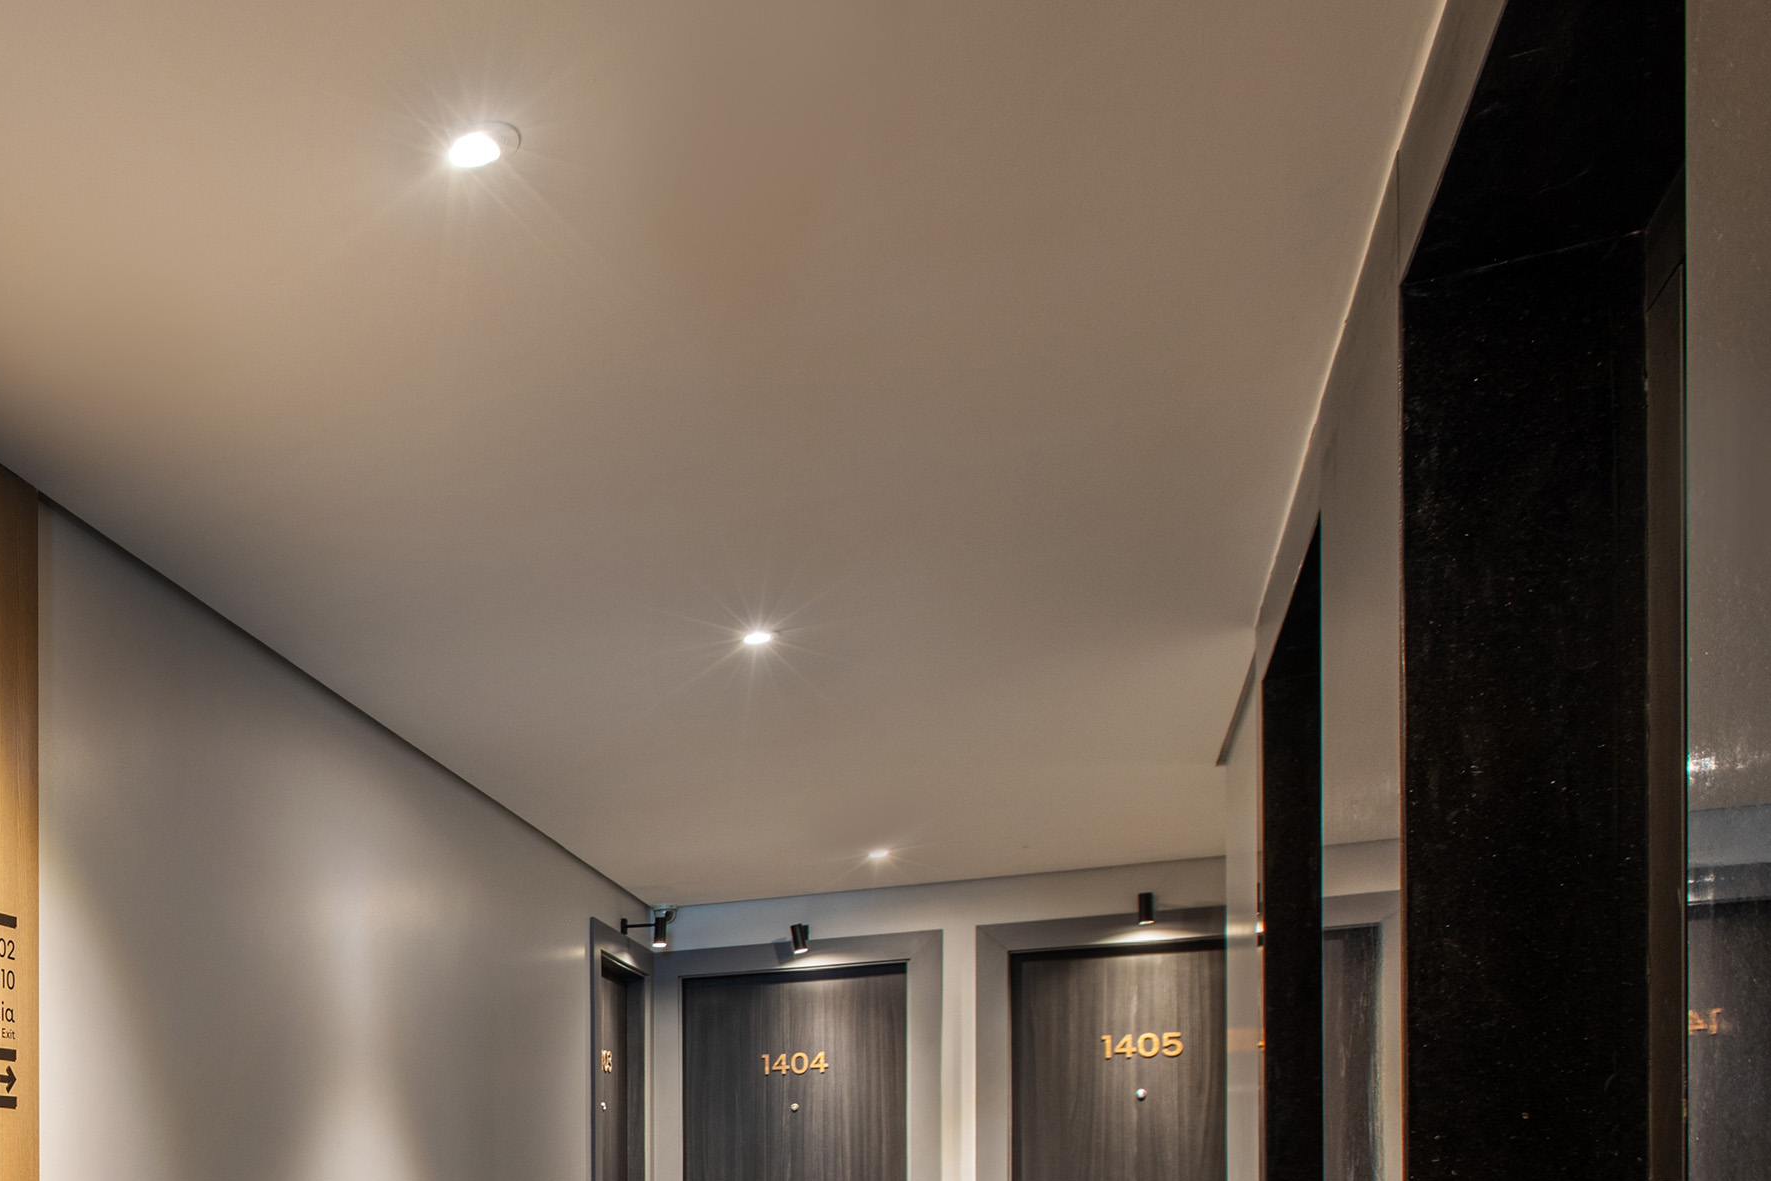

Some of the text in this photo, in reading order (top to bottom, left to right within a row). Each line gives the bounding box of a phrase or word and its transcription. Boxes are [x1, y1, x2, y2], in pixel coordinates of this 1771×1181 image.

[1, 1028, 16, 1040] Exit
[1101, 1031, 1184, 1060] 1405
[761, 1050, 830, 1076] 1404
